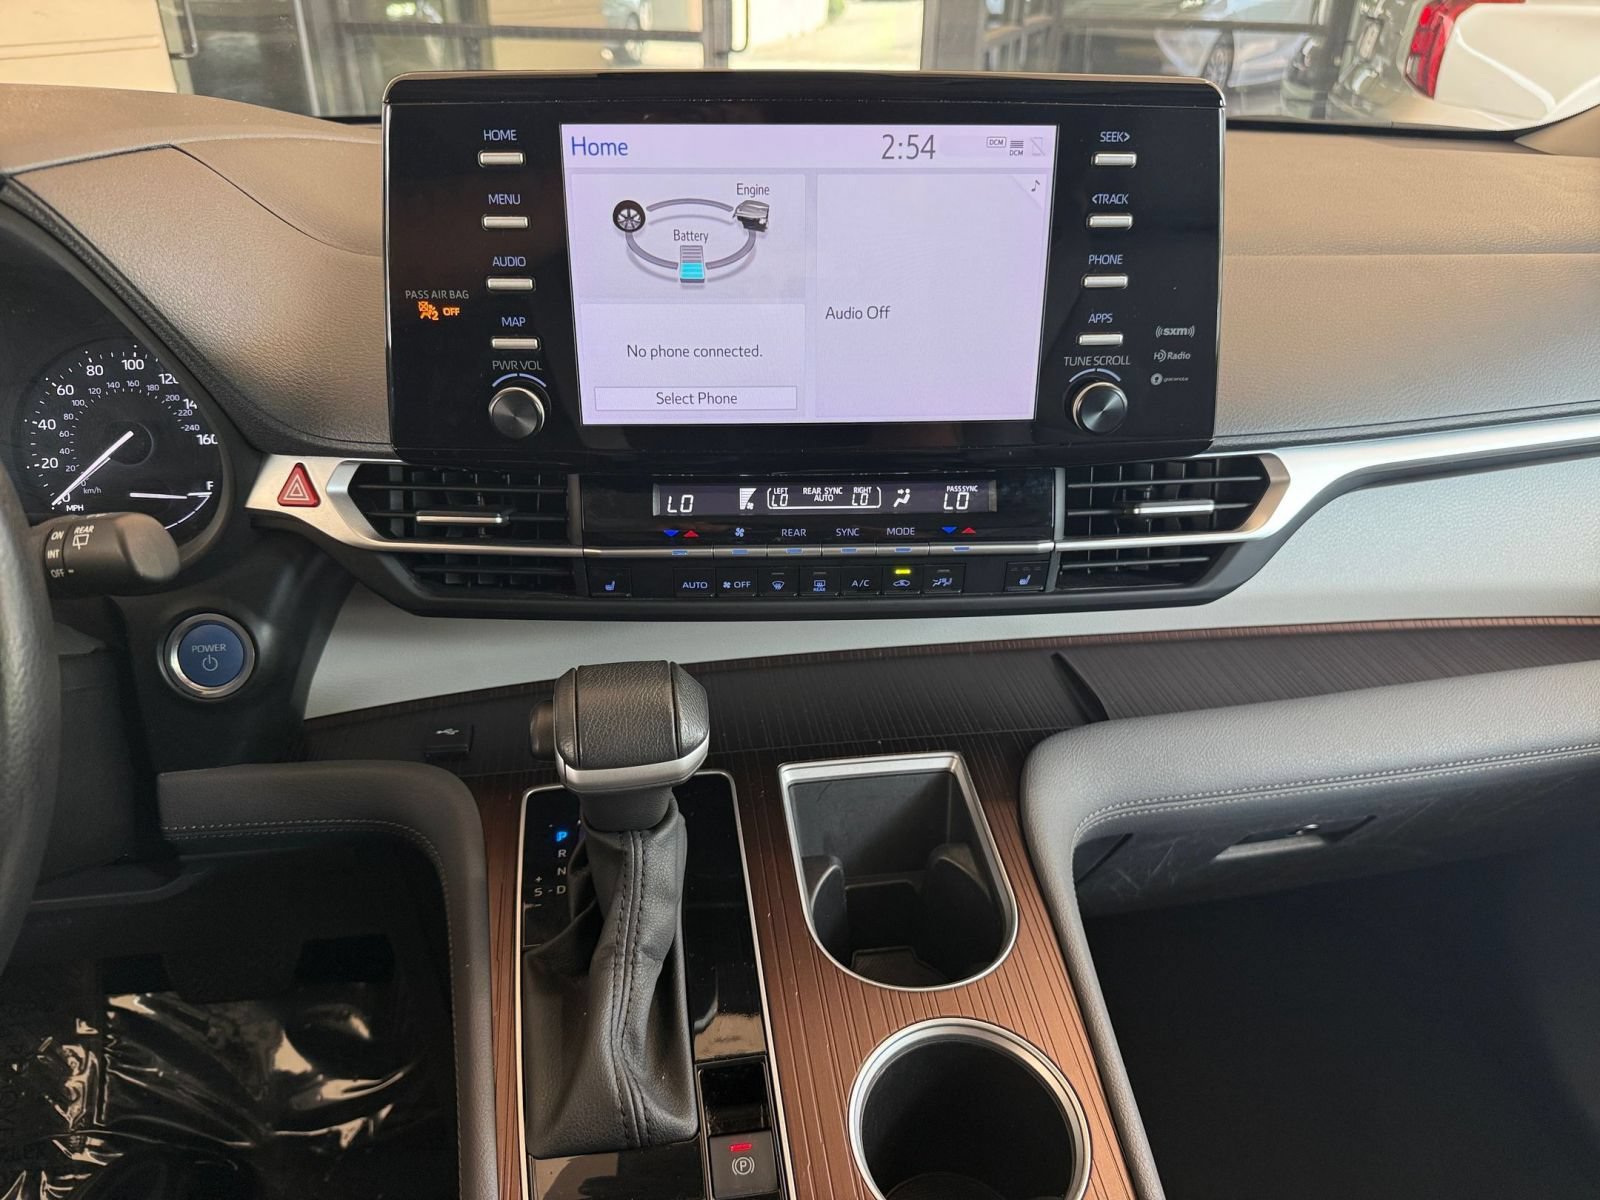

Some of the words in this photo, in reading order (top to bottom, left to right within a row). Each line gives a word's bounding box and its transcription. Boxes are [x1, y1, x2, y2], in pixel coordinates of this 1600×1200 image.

[483, 129, 517, 141] HOME
[571, 136, 629, 156] Home
[881, 134, 936, 160] 2:54
[988, 138, 1004, 146] DCM
[736, 183, 770, 198] Engine
[488, 194, 521, 205] MENU
[673, 229, 709, 244] Battery
[492, 256, 527, 267] AUDIO
[1088, 254, 1124, 265] PHONE
[405, 290, 429, 299] PASS
[431, 290, 448, 299] AIR
[450, 290, 470, 299] BAG
[442, 307, 460, 317] OFF
[825, 306, 863, 320] Audio
[866, 305, 891, 320] Off
[501, 316, 526, 327] MAP
[1088, 313, 1113, 324] APPS
[627, 344, 647, 358] No
[650, 344, 690, 360] phone
[693, 344, 763, 358] connected.
[1167, 351, 1191, 360] Radio
[121, 359, 144, 371] 100
[492, 360, 519, 371] PWR
[520, 360, 543, 371] VOL
[1064, 356, 1092, 366] TUNE
[1093, 355, 1131, 366] SCROLL
[86, 365, 104, 376] 80
[106, 381, 120, 389] 140
[126, 379, 140, 387] 160
[146, 384, 160, 392] 180
[56, 384, 74, 396] 60
[88, 387, 102, 395] 120
[71, 399, 85, 407] 100
[165, 394, 180, 402] 200
[656, 391, 694, 405] Select
[697, 391, 738, 405] Phone
[182, 398, 198, 409] 14
[177, 409, 193, 417] 220
[37, 418, 57, 431] 40
[184, 424, 200, 432] 240
[59, 430, 70, 438] 60
[59, 447, 70, 455] 40
[41, 457, 59, 469] 20
[65, 464, 76, 472] 20
[83, 486, 102, 494] km/h
[206, 481, 214, 490] F
[802, 487, 822, 495] REAR
[824, 487, 843, 495] SYNC
[853, 486, 872, 494] RIGHT
[813, 494, 834, 502] AUTO
[65, 504, 84, 512] MPH
[73, 525, 95, 534] REAR
[781, 528, 807, 537] REAR
[835, 527, 860, 537] SYNC
[886, 527, 915, 536] MODE
[51, 530, 65, 541] ON
[47, 549, 60, 559] INT
[50, 569, 65, 578] OFF
[682, 581, 708, 589] AUTO
[733, 581, 751, 589] OFF
[851, 579, 870, 588] A/C
[191, 643, 227, 653] POWER
[556, 831, 568, 842] P
[557, 849, 567, 858] R
[557, 866, 567, 876] N
[534, 887, 543, 897] S
[556, 885, 567, 895] D
